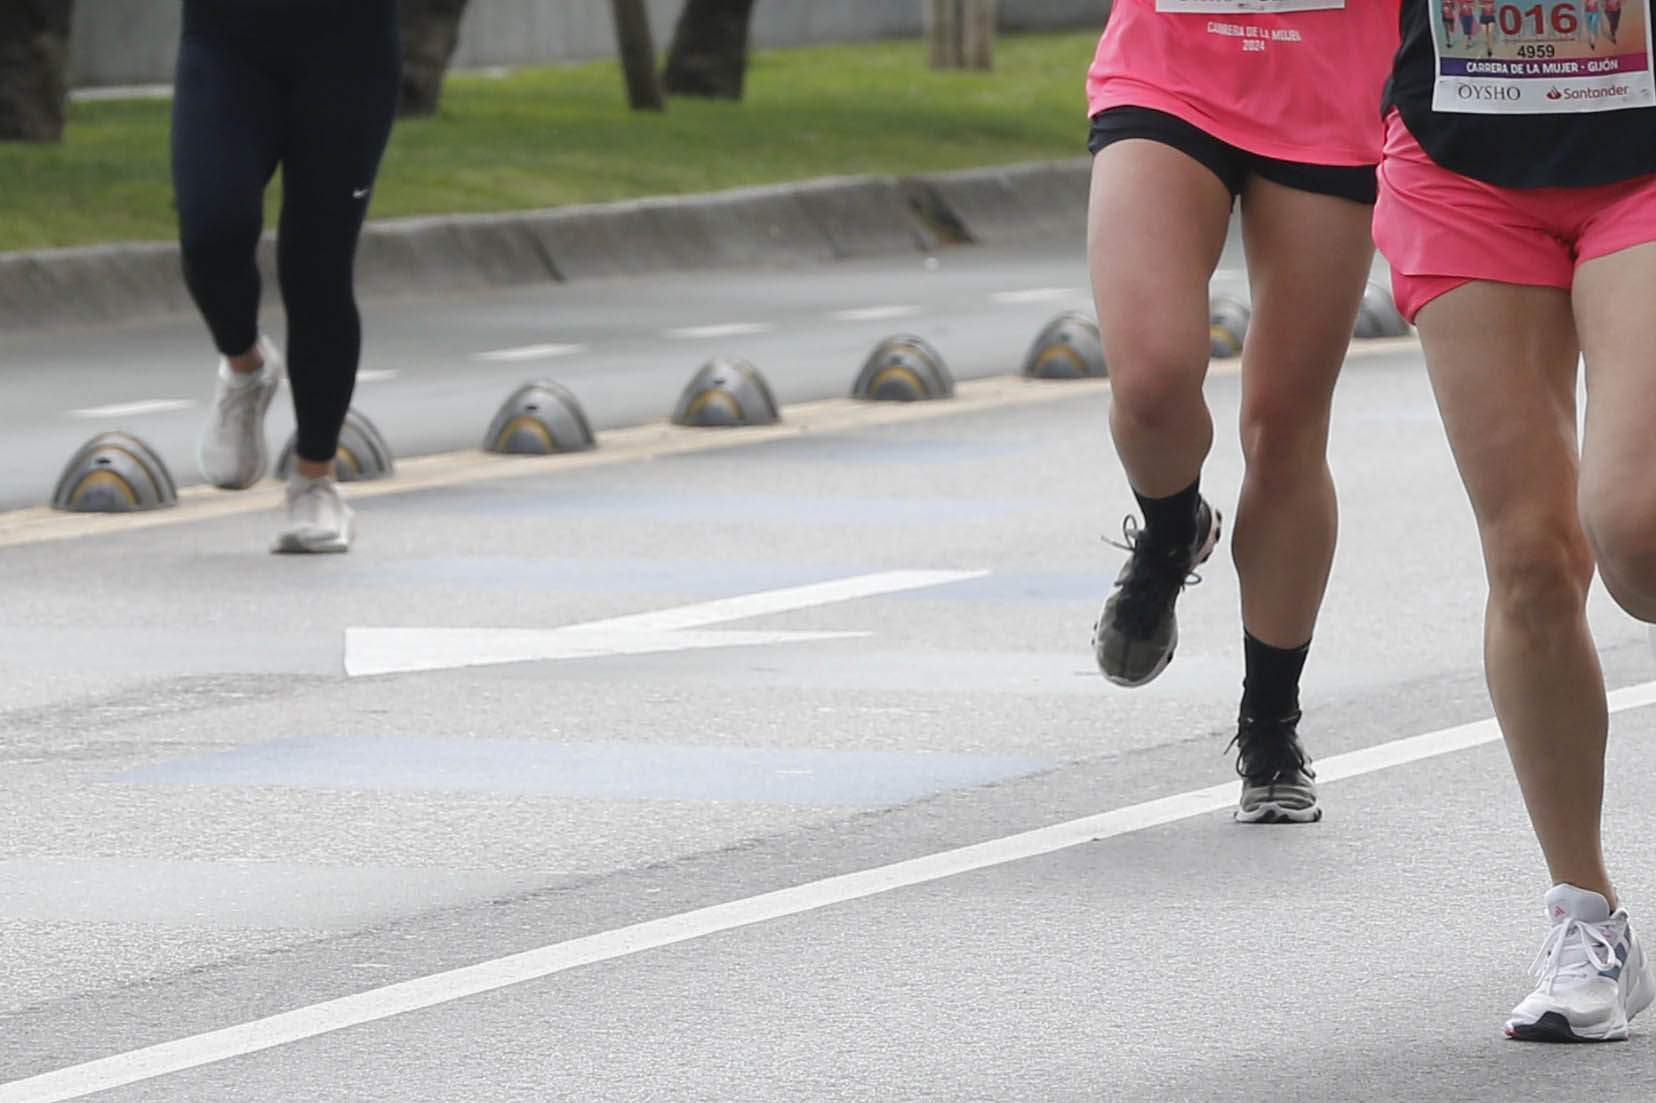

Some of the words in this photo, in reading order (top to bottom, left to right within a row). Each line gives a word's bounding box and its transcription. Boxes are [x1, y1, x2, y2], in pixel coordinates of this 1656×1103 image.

[1499, 2, 1579, 36] 016
[1517, 44, 1555, 58] 4959
[1466, 61, 1509, 74] CARRERA
[1511, 62, 1524, 74] DE
[1526, 63, 1540, 74] LA
[1542, 62, 1578, 73] MUJER
[1457, 84, 1521, 100] OYSHO
[1563, 85, 1629, 100] Santander
